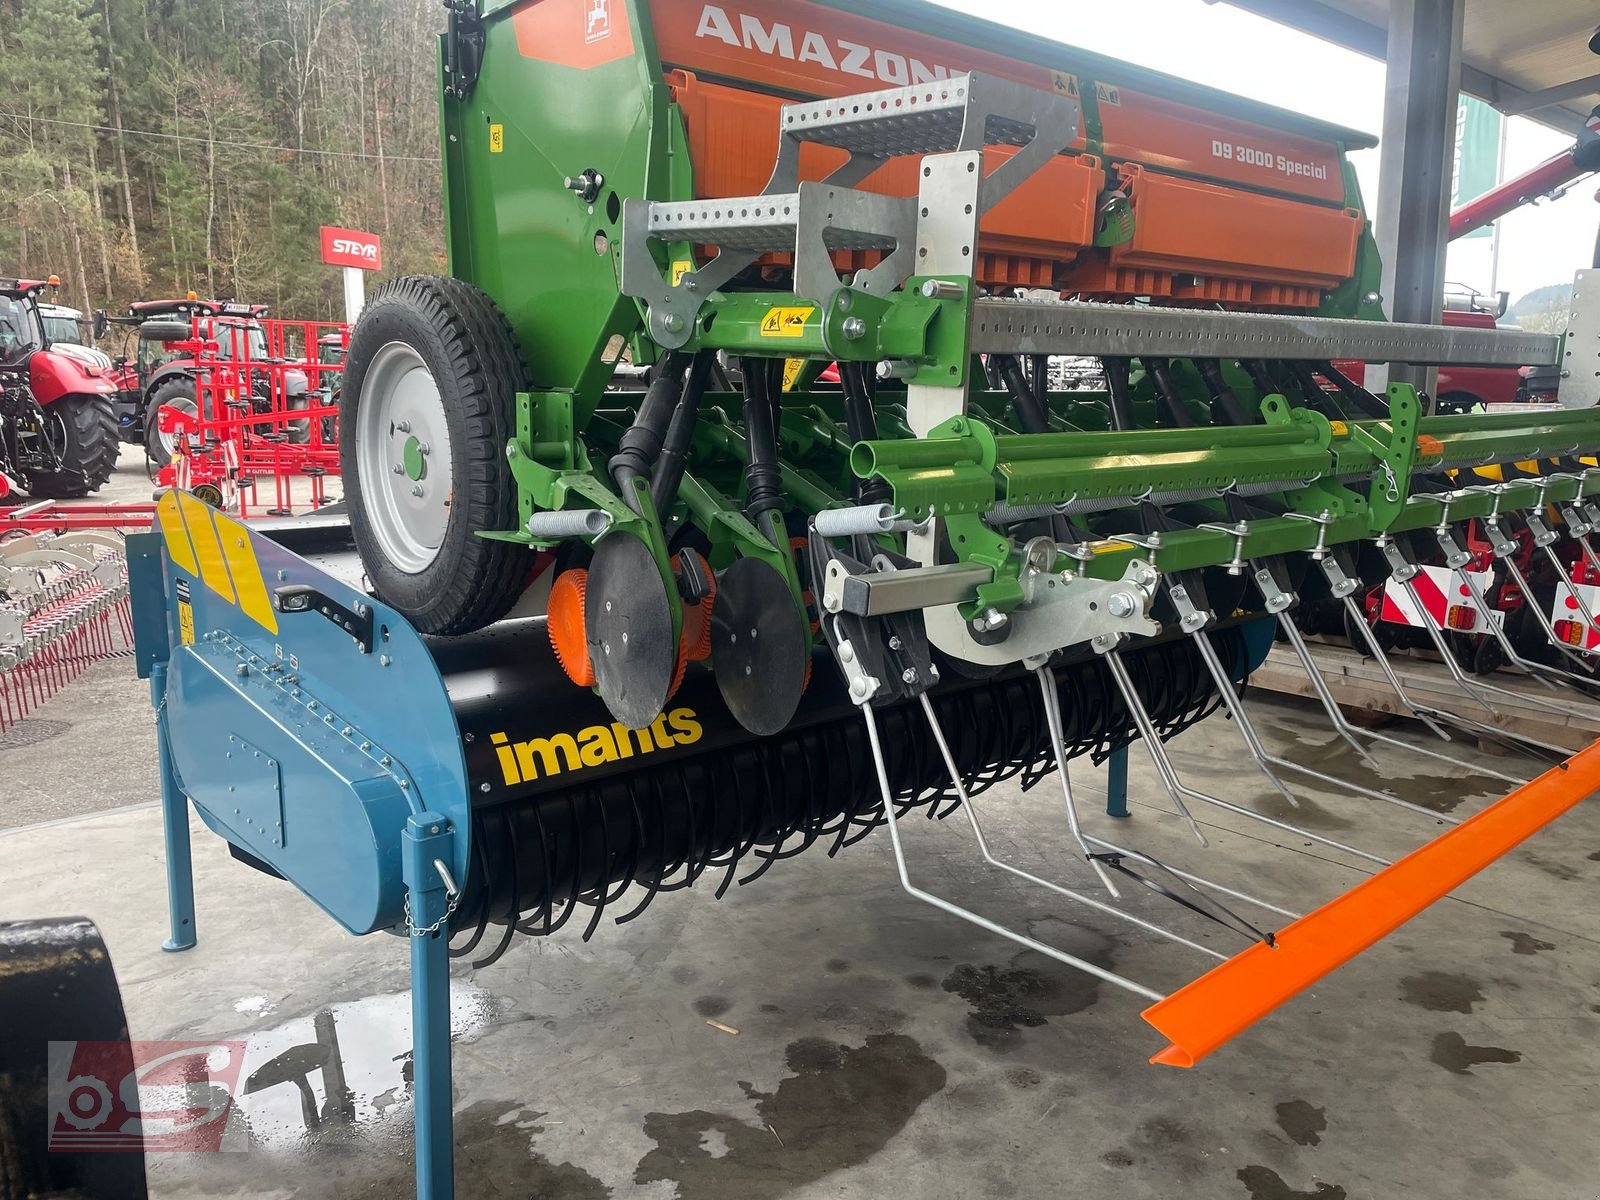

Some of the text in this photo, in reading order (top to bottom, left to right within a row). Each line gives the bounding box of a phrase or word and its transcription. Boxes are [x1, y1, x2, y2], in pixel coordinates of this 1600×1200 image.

[695, 4, 969, 87] AMAZON
[1212, 140, 1327, 180] D9 3000 Special
[332, 239, 378, 258] STEYR
[489, 707, 704, 786] imants
